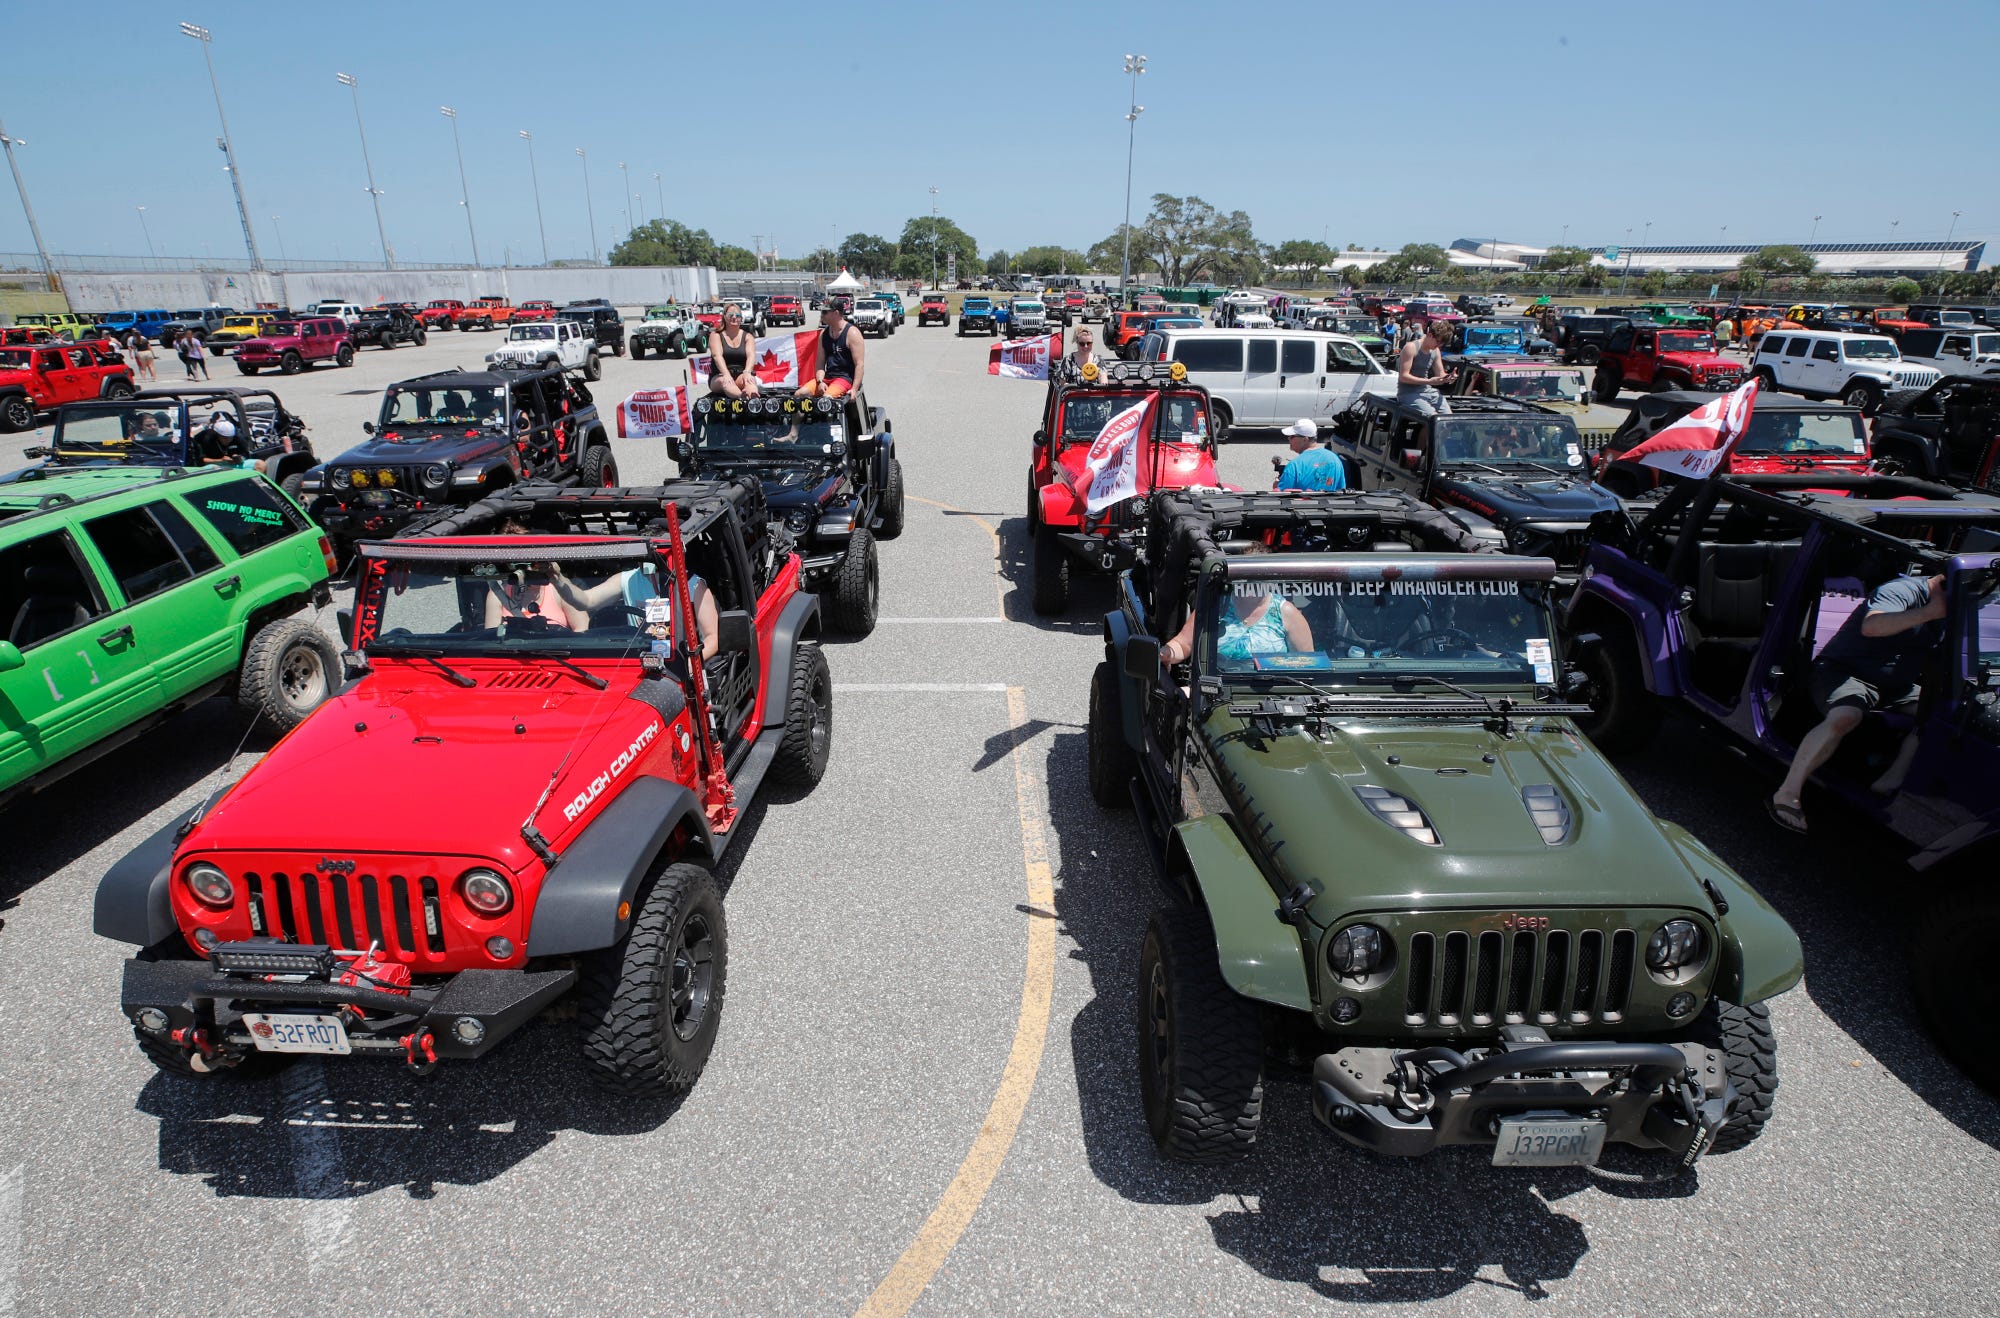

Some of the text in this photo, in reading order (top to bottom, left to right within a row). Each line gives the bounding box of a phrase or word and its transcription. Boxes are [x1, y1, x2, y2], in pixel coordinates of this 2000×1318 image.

[714, 400, 726, 413] KC
[731, 400, 743, 413] KC
[783, 400, 796, 413] KC
[801, 399, 813, 412] KC
[1093, 413, 1139, 455] HAWKESBURY
[1100, 448, 1133, 498] WRANGLER
[206, 500, 237, 513] SHOW
[239, 505, 253, 515] NO
[254, 508, 282, 521] MERCY
[1348, 580, 1385, 596] JEEP
[1390, 580, 1476, 596] WRANGLER
[1480, 580, 1520, 596] CLUB
[563, 720, 659, 822] ROUGH COUNTRY
[316, 856, 356, 876] Jeep
[1503, 913, 1549, 932] Jeep
[273, 1024, 339, 1044] 52FR07
[1507, 1135, 1591, 1156] J33PGRL
